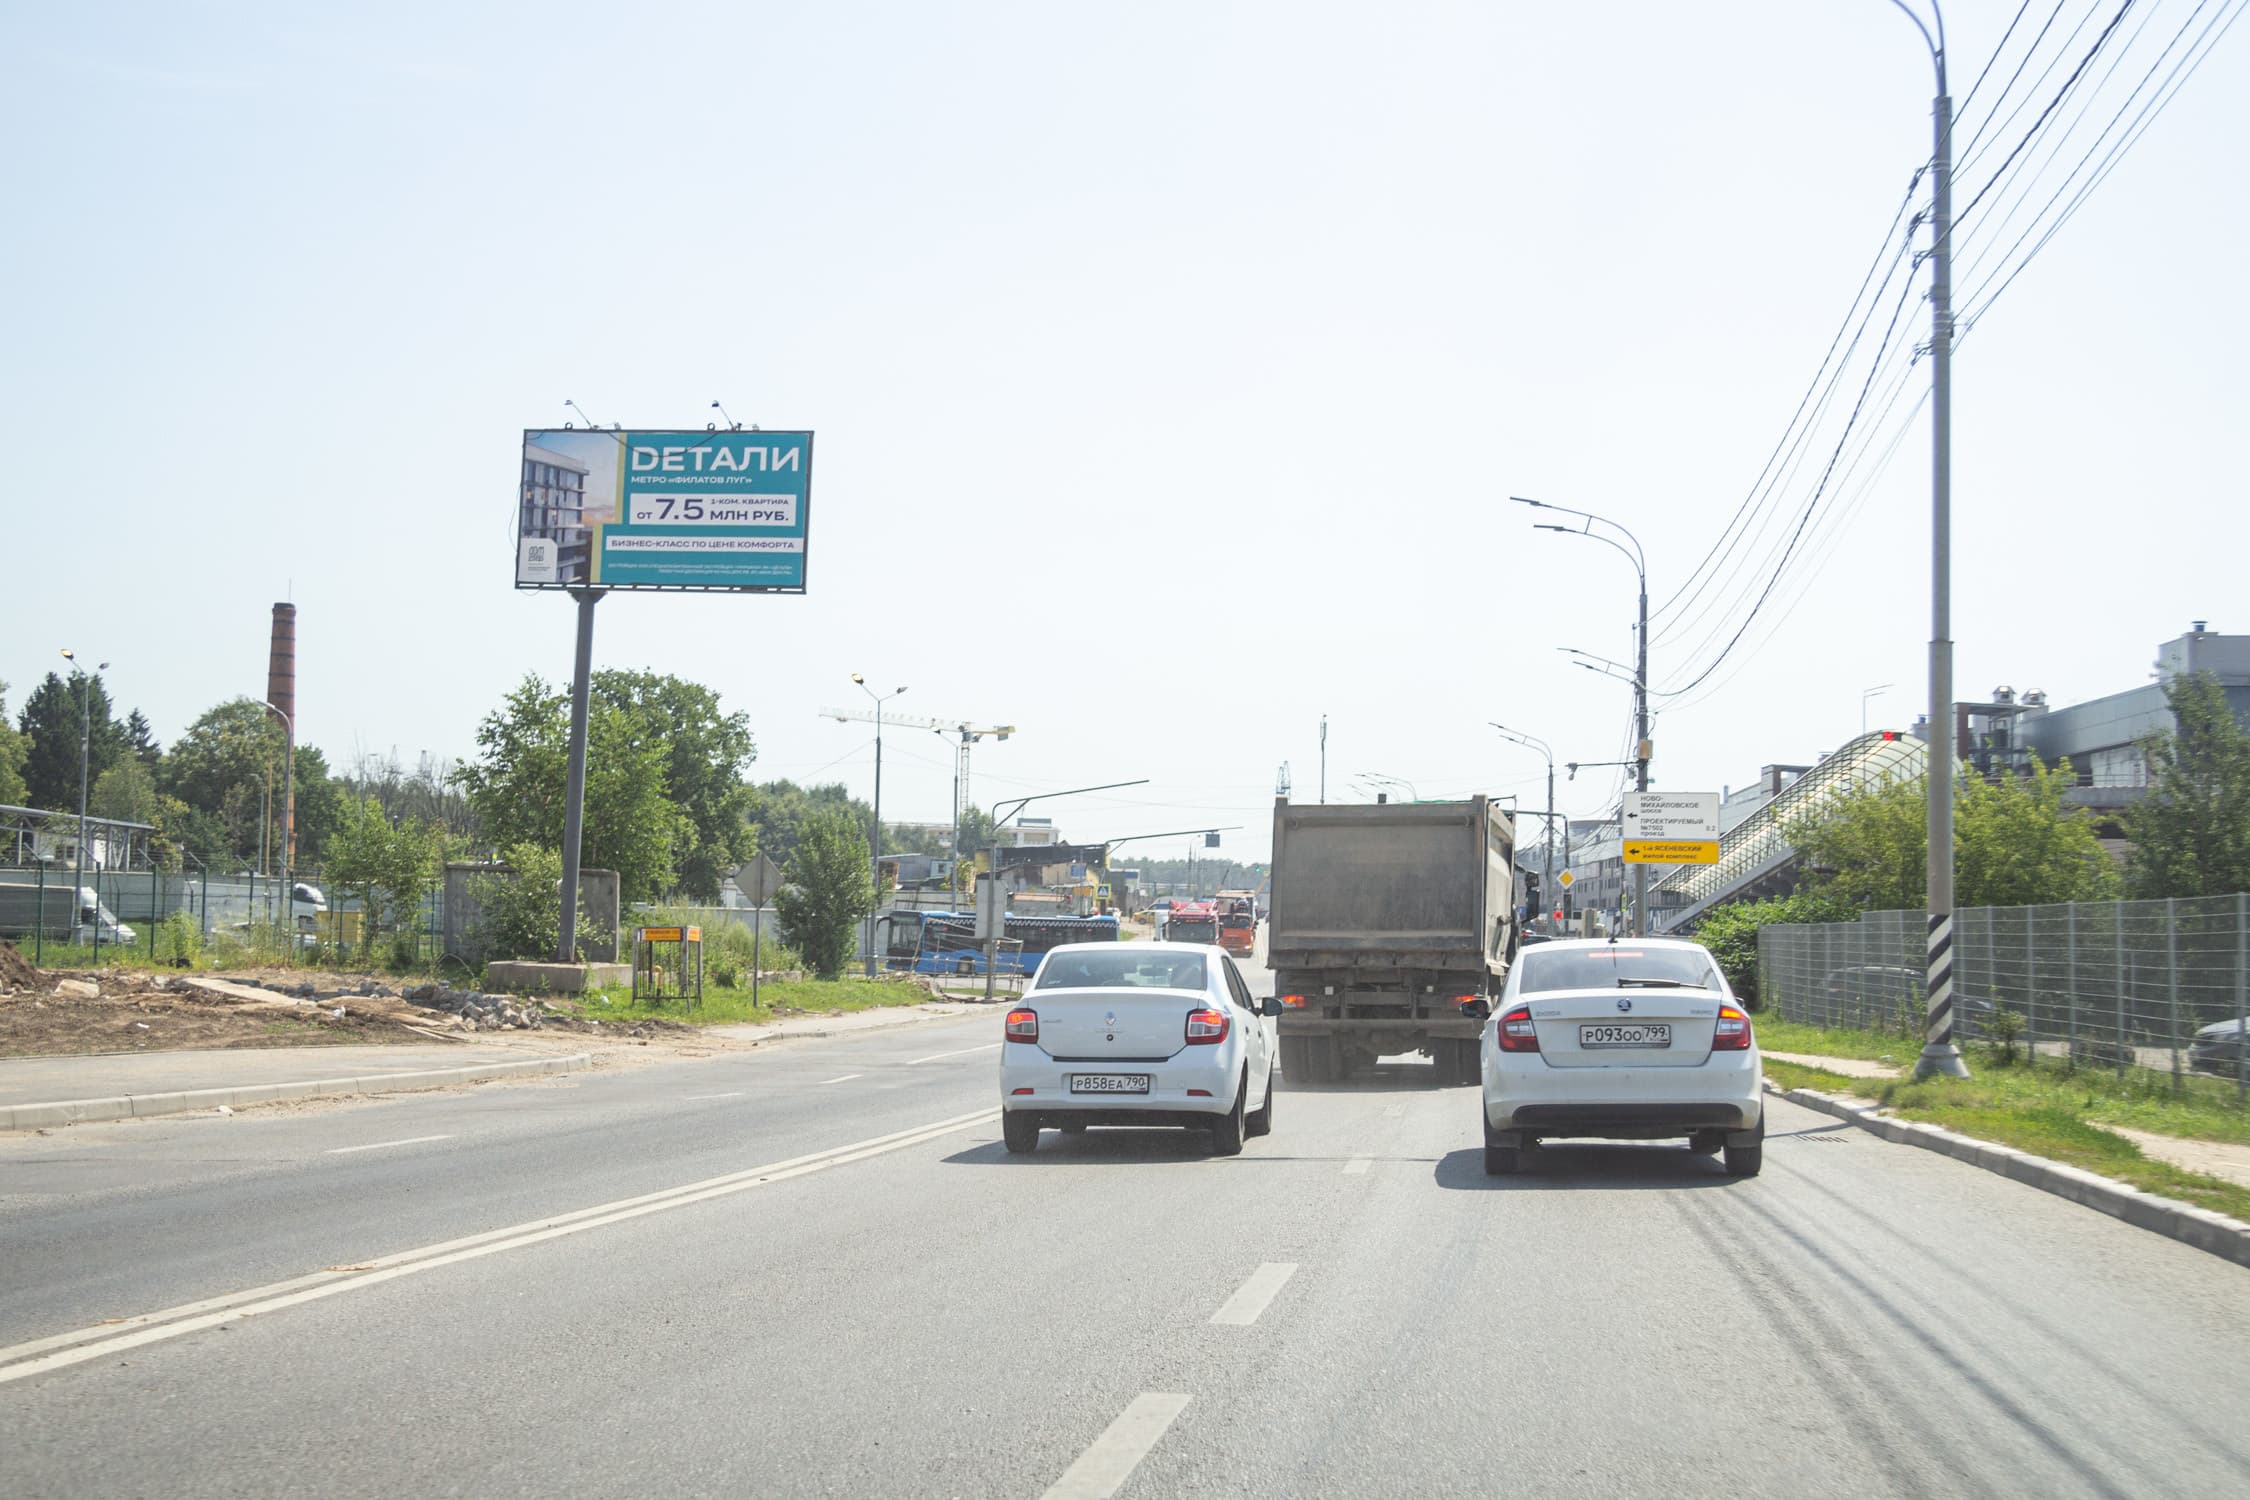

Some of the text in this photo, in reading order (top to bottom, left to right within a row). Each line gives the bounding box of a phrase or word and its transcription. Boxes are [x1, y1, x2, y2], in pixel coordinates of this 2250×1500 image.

[631, 476, 752, 484] МЕТРО «ФИЛАТОВ ЛУГ»
[742, 498, 789, 506] КВАРТИРА
[656, 498, 704, 520] 7.5
[710, 510, 748, 521] МЛН
[752, 510, 789, 521] РУБ.
[611, 539, 795, 549] БИЗНЕС-КЛАСС ПО ЦЕНЕ КОМФОРТА
